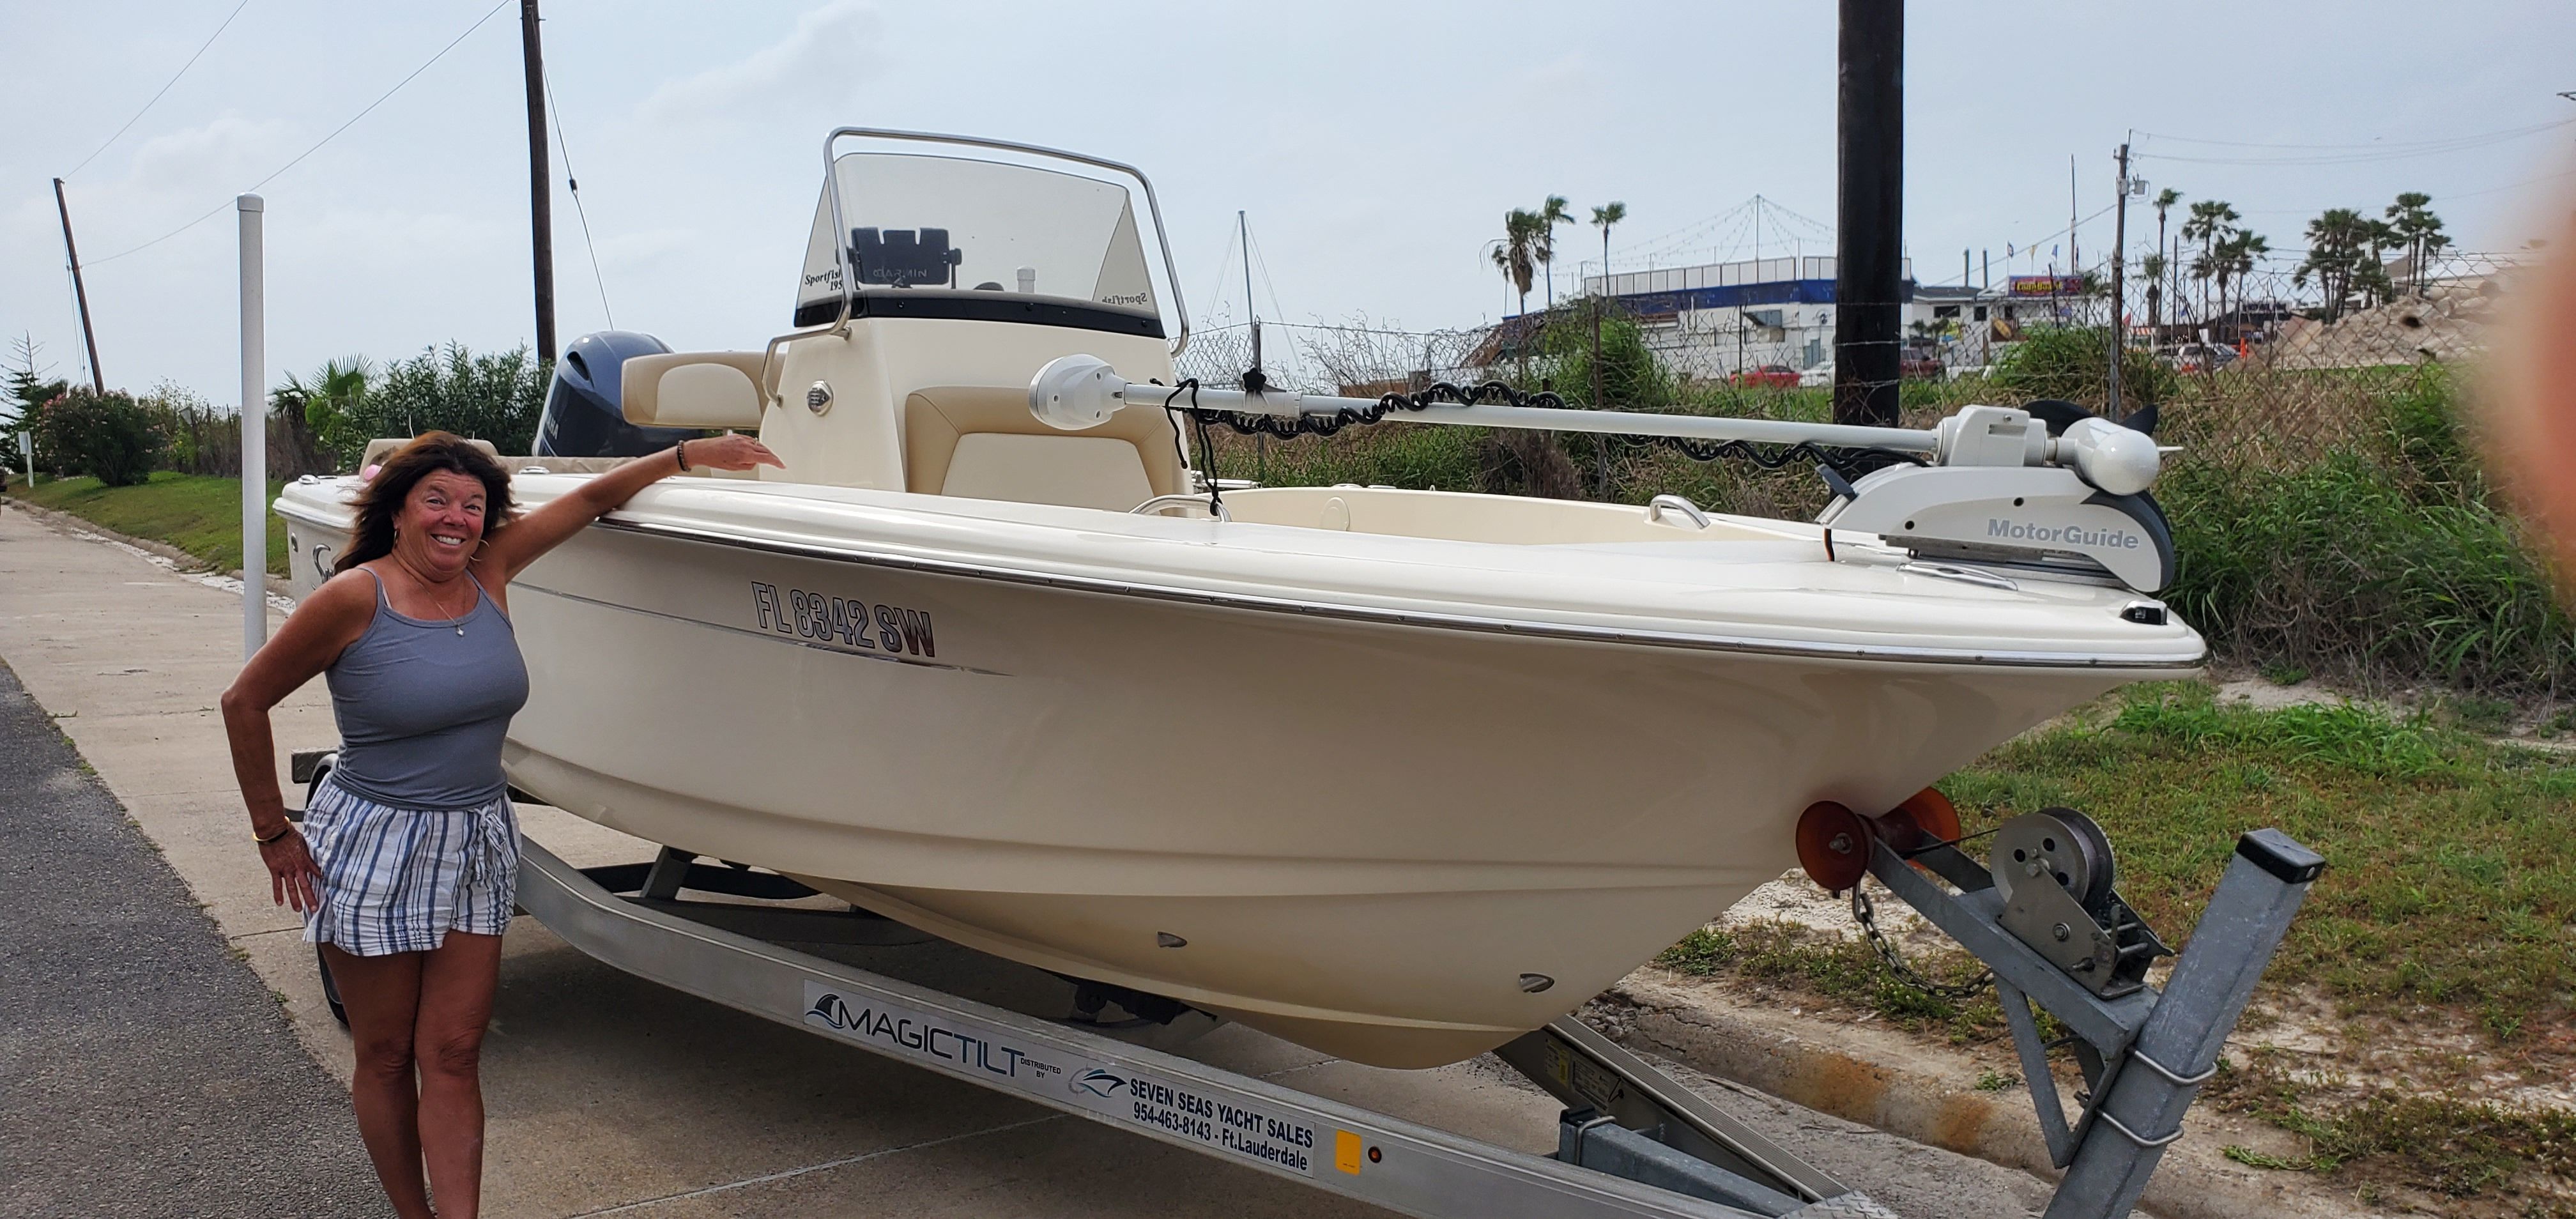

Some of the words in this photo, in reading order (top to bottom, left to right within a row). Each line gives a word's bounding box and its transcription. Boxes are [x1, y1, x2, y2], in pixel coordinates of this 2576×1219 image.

[831, 280, 843, 291] 195
[1988, 519, 2138, 549] MotorGuide
[751, 581, 792, 634] FL
[790, 589, 875, 648] 8342
[874, 604, 935, 657] SW
[1020, 1057, 1061, 1074] DISTRIBUTED
[1036, 1070, 1045, 1078] BY
[1130, 1078, 1174, 1107] SEVEN
[1178, 1092, 1213, 1118] SEAS
[1217, 1103, 1263, 1133] YACHT
[1268, 1118, 1313, 1148] SALES
[1134, 1101, 1211, 1141] 954-463-8143
[1222, 1128, 1308, 1170] Ft.Lauderdale
